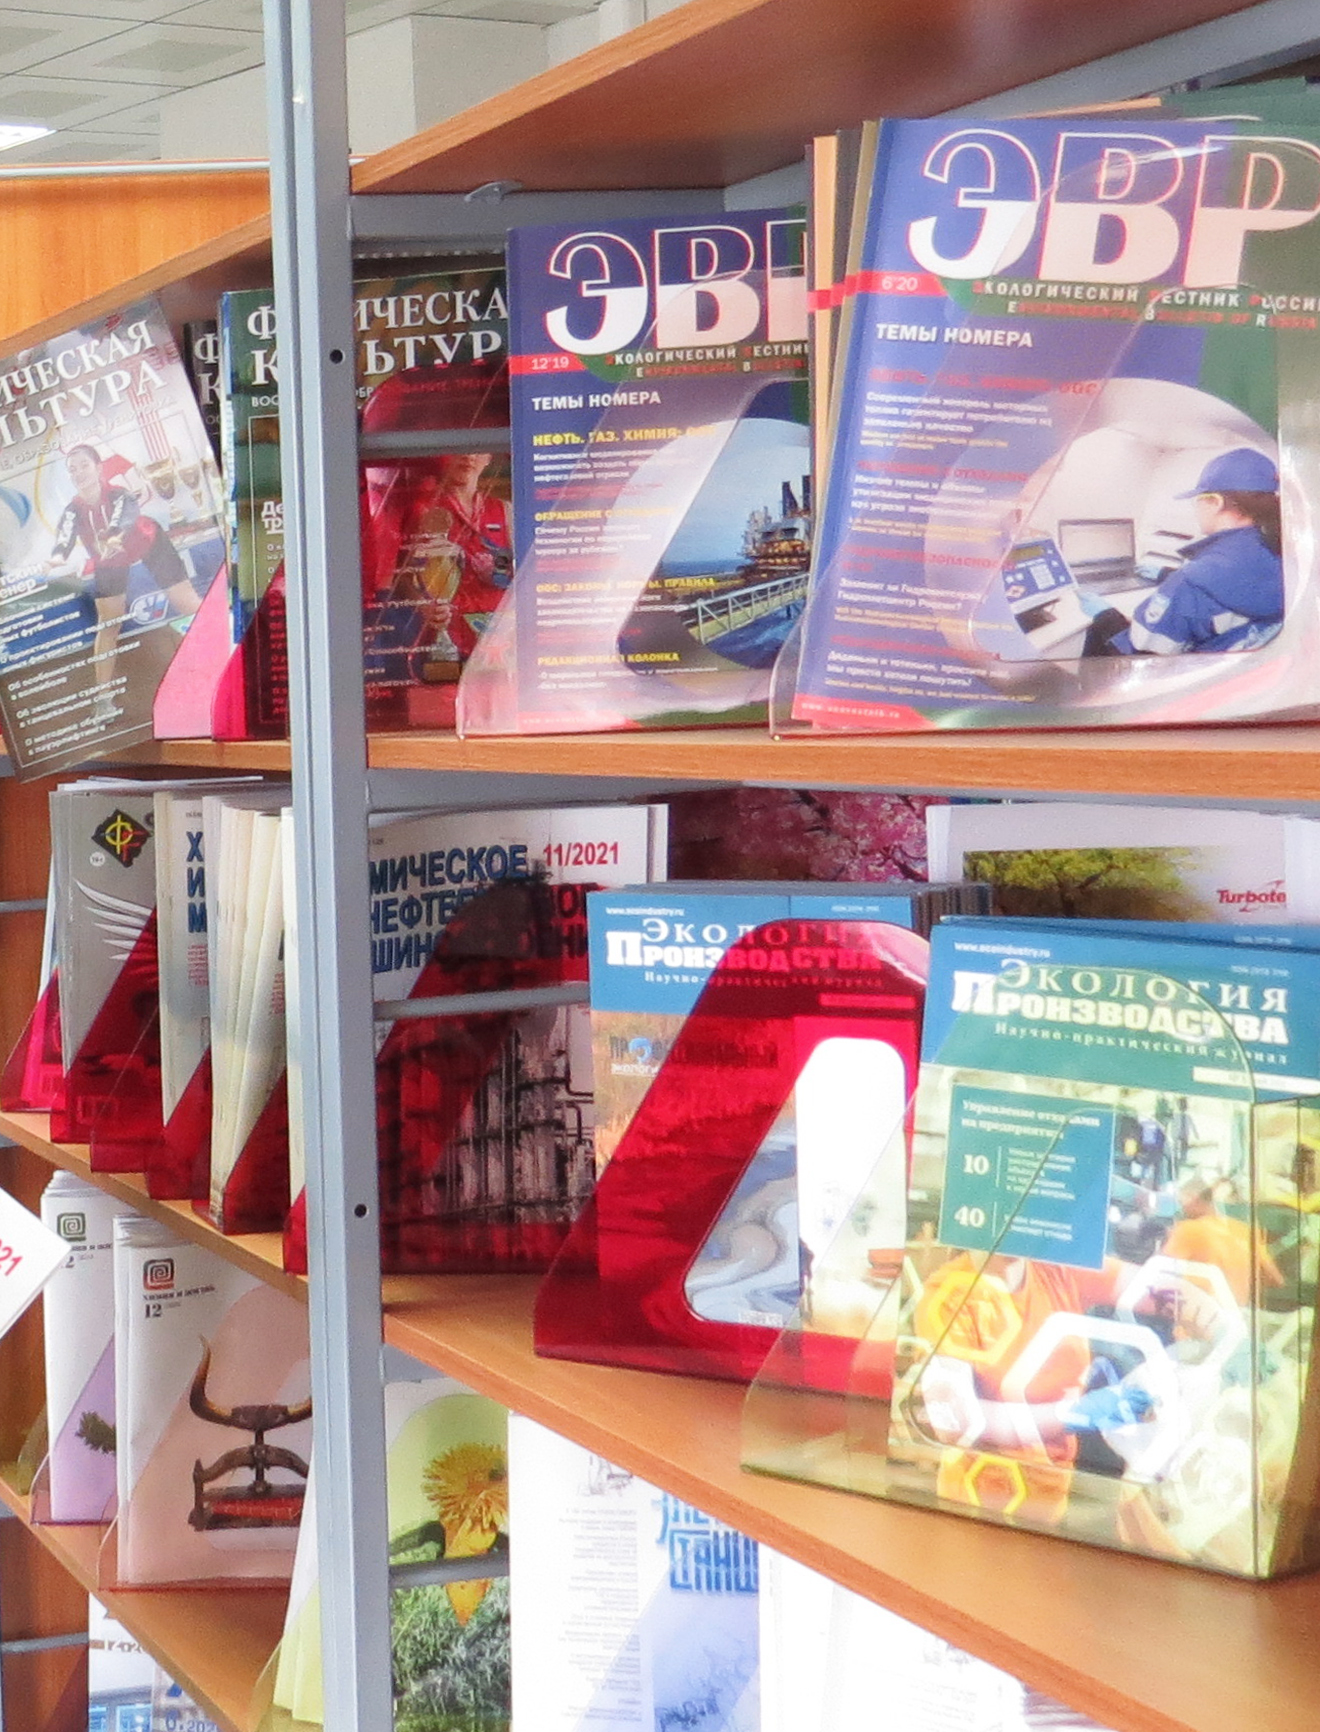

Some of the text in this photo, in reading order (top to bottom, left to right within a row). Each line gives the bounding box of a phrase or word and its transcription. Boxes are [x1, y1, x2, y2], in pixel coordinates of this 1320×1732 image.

[907, 128, 1320, 288] ЭВР
[882, 276, 918, 291] 6'20
[354, 287, 509, 331] ИЧЕСКА
[876, 323, 1033, 348] ТЕМЫ НОМЕРА
[363, 330, 502, 376] ЬТУР
[743, 344, 809, 357] ЕСТНИ
[531, 356, 569, 371] 12'19
[532, 391, 661, 411] ТЕМЫ НОМЕРА
[533, 433, 584, 447] НЕФТЬ.
[0, 563, 43, 586] тский
[628, 652, 680, 664] КОЛОНКА
[543, 842, 619, 866] 11/2021
[370, 844, 529, 895] МИЧЕСКОЕ
[998, 958, 1289, 1013] ЭКОЛОГИЯ
[963, 1154, 989, 1175] 10
[954, 1206, 985, 1228] 40
[144, 1303, 162, 1318] 12
